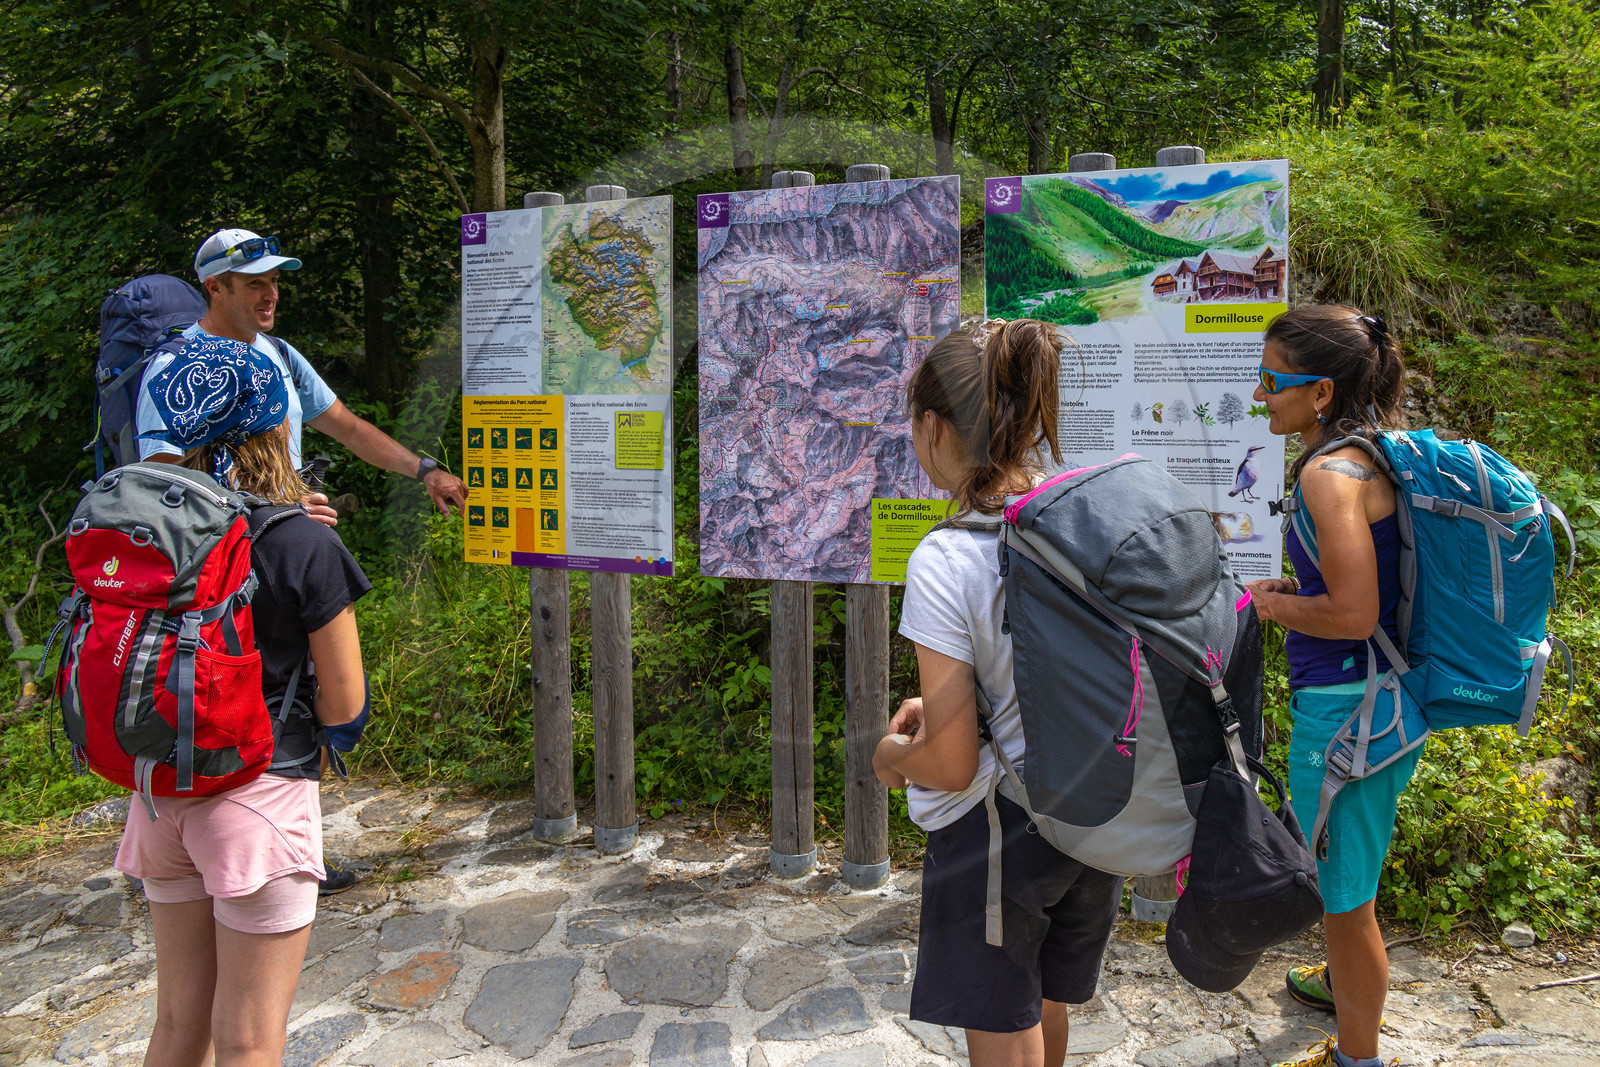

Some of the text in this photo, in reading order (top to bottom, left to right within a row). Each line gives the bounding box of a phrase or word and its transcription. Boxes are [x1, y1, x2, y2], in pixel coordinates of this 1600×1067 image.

[1196, 313, 1264, 324] Dormillouse
[894, 503, 931, 511] cascades
[891, 512, 943, 521] Dormillouse
[94, 576, 125, 588] deuter
[113, 610, 136, 667] CLIMBER
[1453, 685, 1499, 703] deuter
